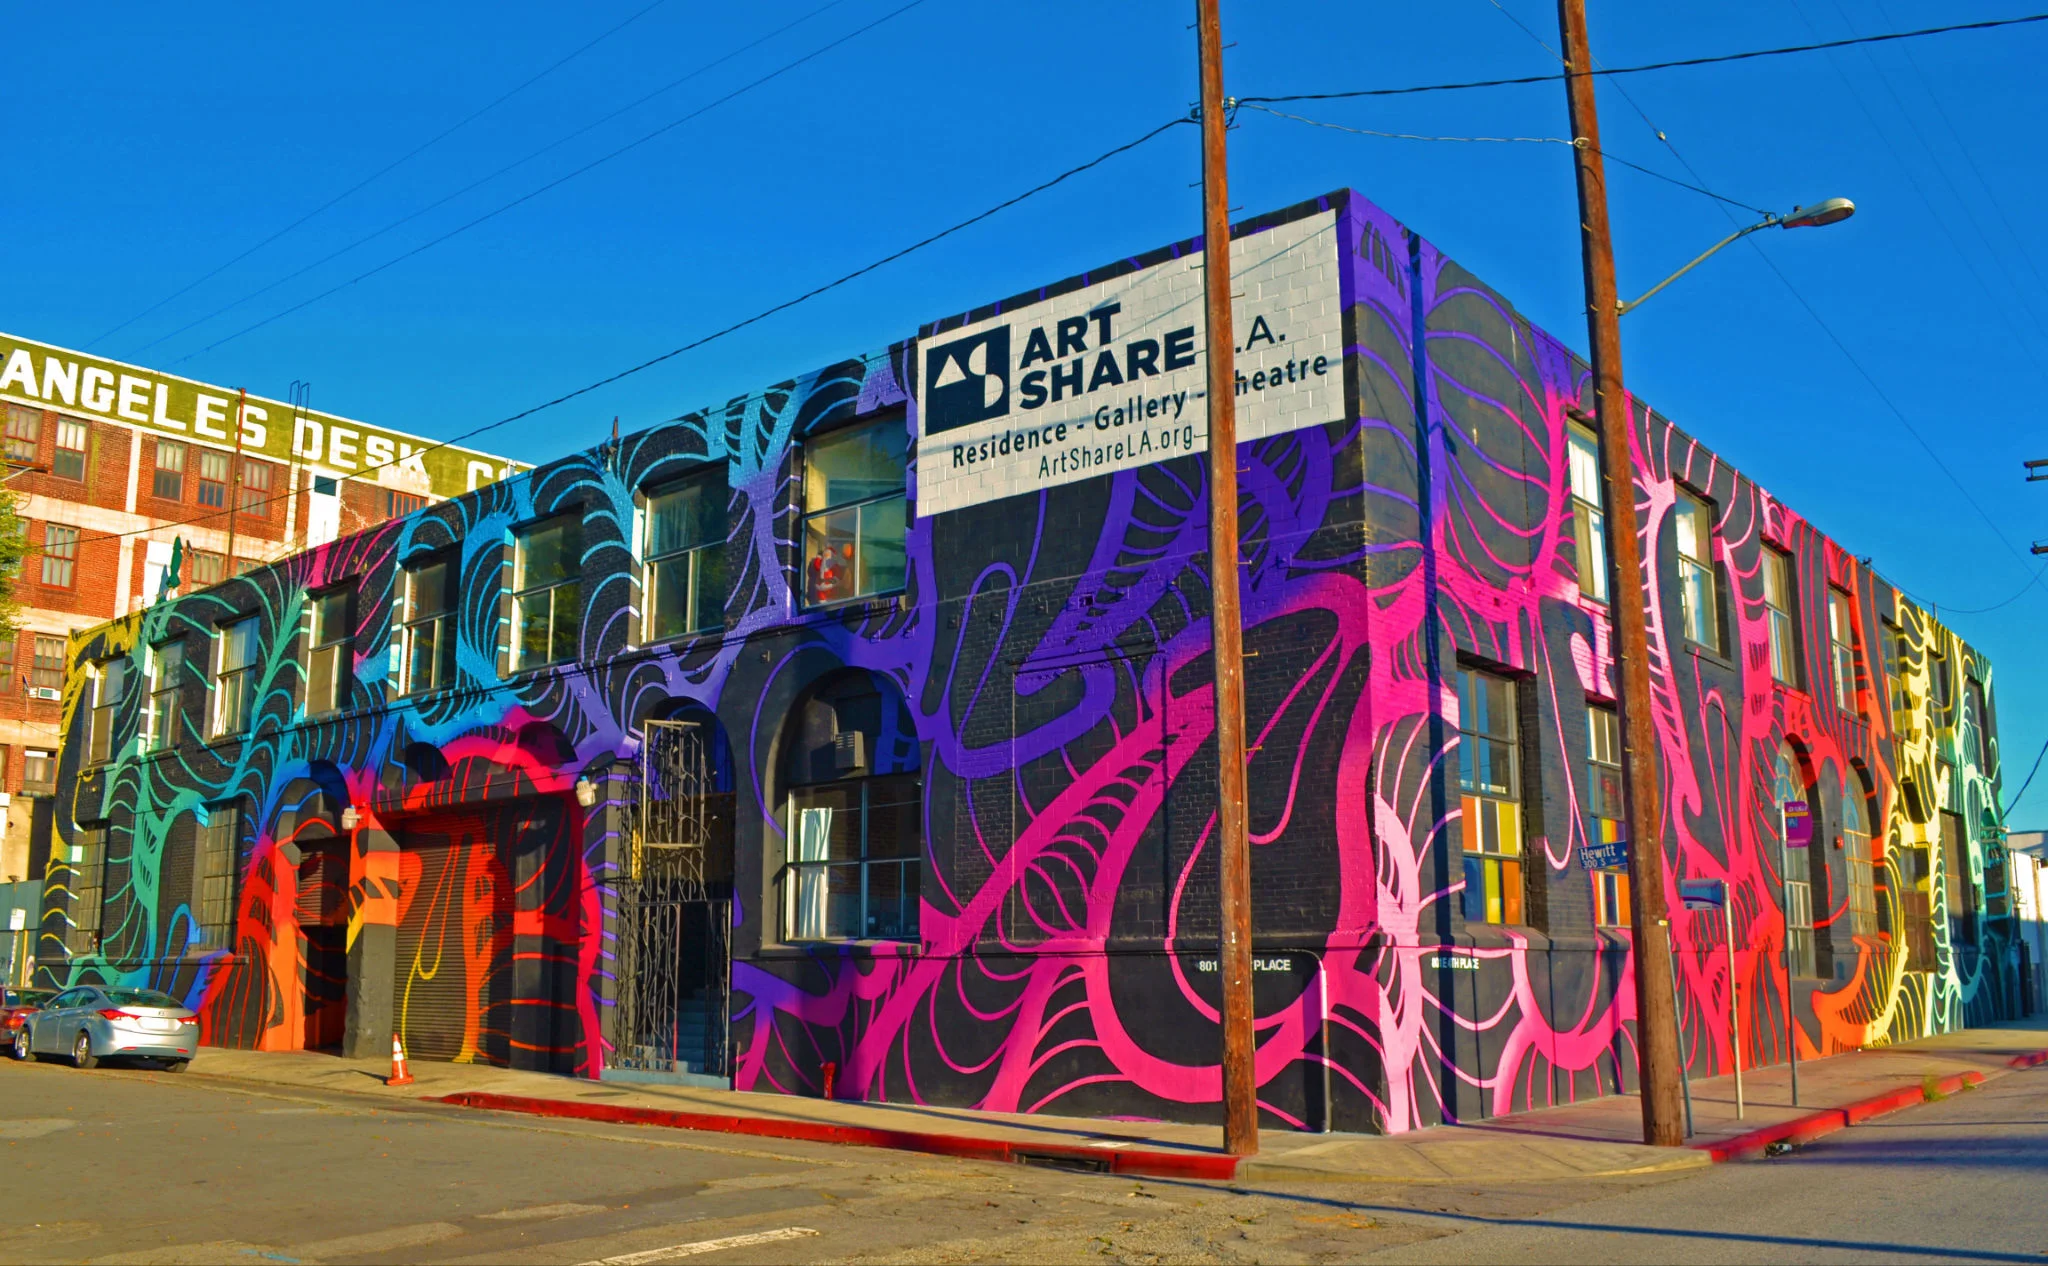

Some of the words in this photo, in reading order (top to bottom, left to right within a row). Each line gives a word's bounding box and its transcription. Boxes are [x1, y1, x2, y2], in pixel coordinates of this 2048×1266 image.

[1019, 302, 1121, 370] ART
[1019, 326, 1196, 410] SHARE
[1235, 314, 1286, 353] .A.
[0, 348, 268, 448] ANGELES
[292, 416, 430, 485] DESK
[952, 419, 1067, 468] Residence
[1094, 389, 1187, 431] Gallery
[1234, 354, 1328, 396] heatre
[1038, 422, 1194, 479] ArtShareLA.org
[1580, 844, 1616, 861] Hewitt
[1199, 960, 1218, 972] 801
[1253, 959, 1292, 972] PLACE
